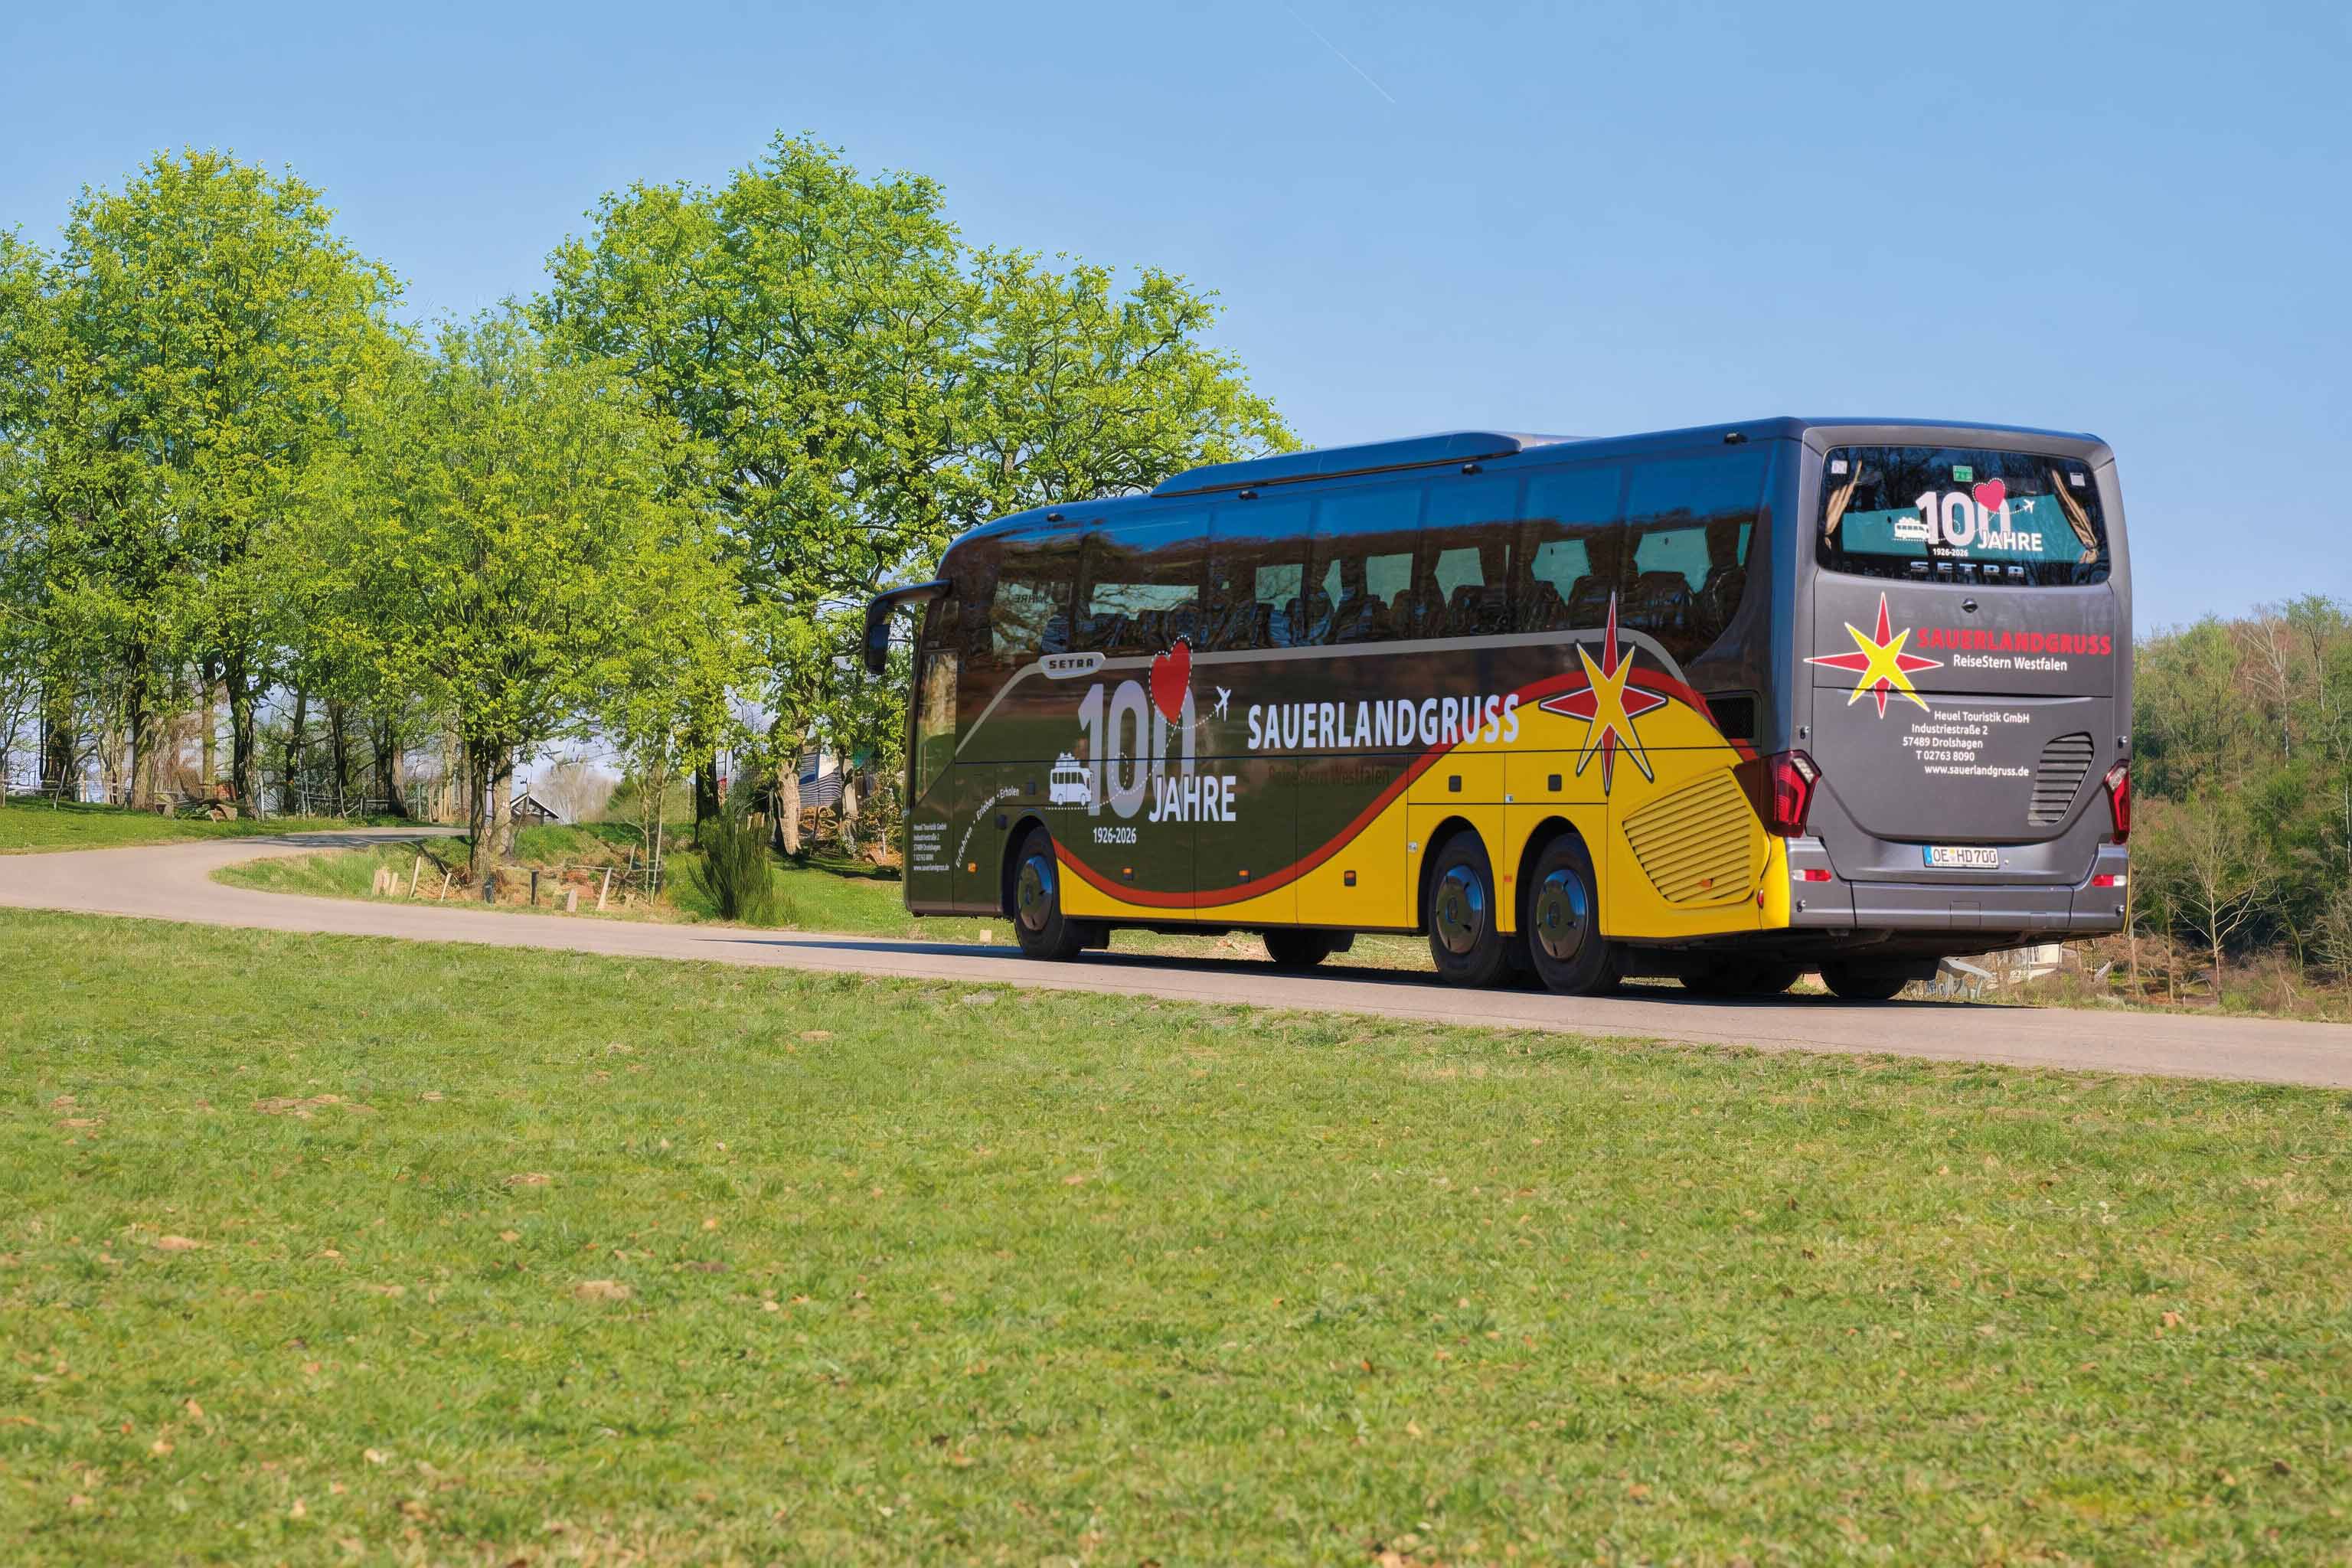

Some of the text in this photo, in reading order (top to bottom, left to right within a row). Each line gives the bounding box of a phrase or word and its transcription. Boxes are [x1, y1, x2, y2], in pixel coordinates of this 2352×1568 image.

[1916, 491, 2011, 546] 100
[1978, 530, 2043, 551] JAHRE
[1932, 547, 1968, 557] 1926-2026
[1910, 561, 2024, 577] SETRA
[1916, 628, 2112, 655] SAUERLANDGRUSS
[1049, 658, 1093, 669] SETRA
[1953, 654, 2067, 671] ReiseStern Westfalen
[1248, 694, 1519, 750] SAUERLANDGRUSS
[1934, 710, 2030, 724] Heuel Touristik GmbH
[1912, 723, 1988, 735] Industriestraße 2
[1903, 737, 1983, 750] 57489 Drolshagen
[1916, 751, 1975, 761] T 02763 8090
[1925, 765, 2029, 777] www.sauerlandgruss.de
[1000, 785, 1020, 799] Erholen
[1148, 776, 1236, 822] JAHRE
[1093, 827, 1136, 844] 1926-2026
[1933, 849, 1949, 862] OE
